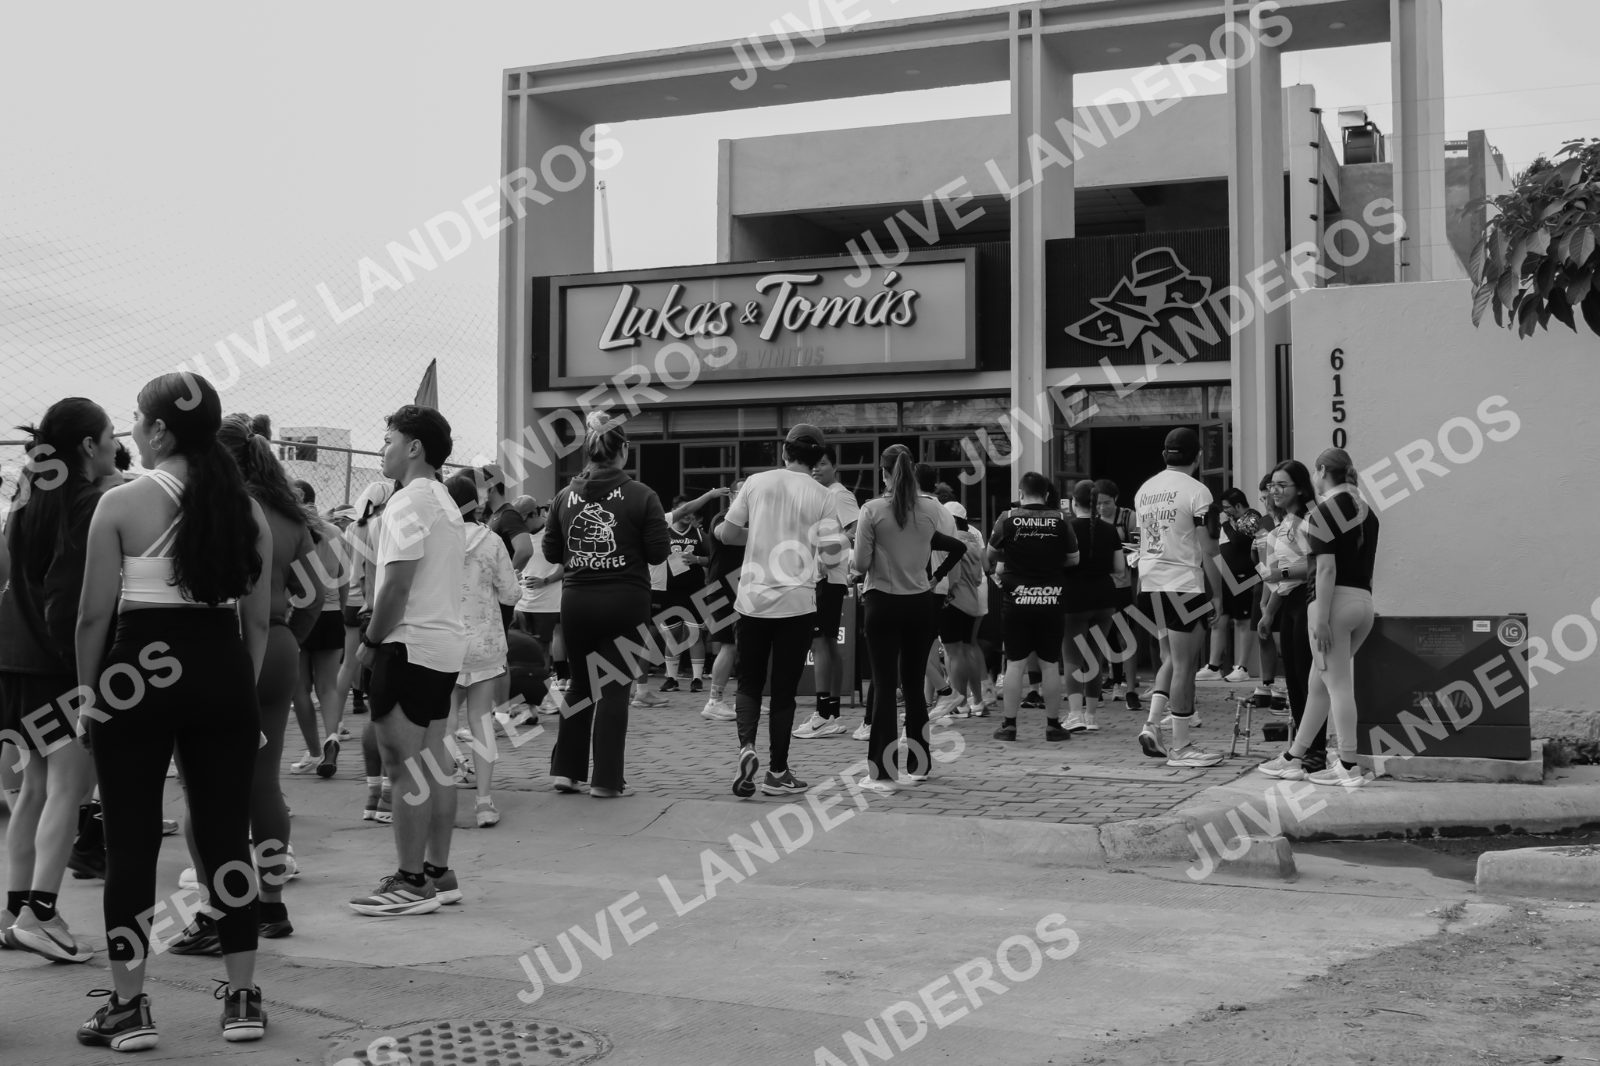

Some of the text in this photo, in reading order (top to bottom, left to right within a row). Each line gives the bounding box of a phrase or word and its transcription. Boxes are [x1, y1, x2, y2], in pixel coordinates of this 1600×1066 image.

[599, 271, 918, 350] Lukas & Tomás
[1330, 347, 1347, 450] 6150
[1139, 489, 1178, 507] Running
[1012, 517, 1057, 527] OMNILIFE
[568, 557, 590, 569] JUST
[1011, 585, 1062, 596] AKRON
[1505, 626, 1518, 637] IG
